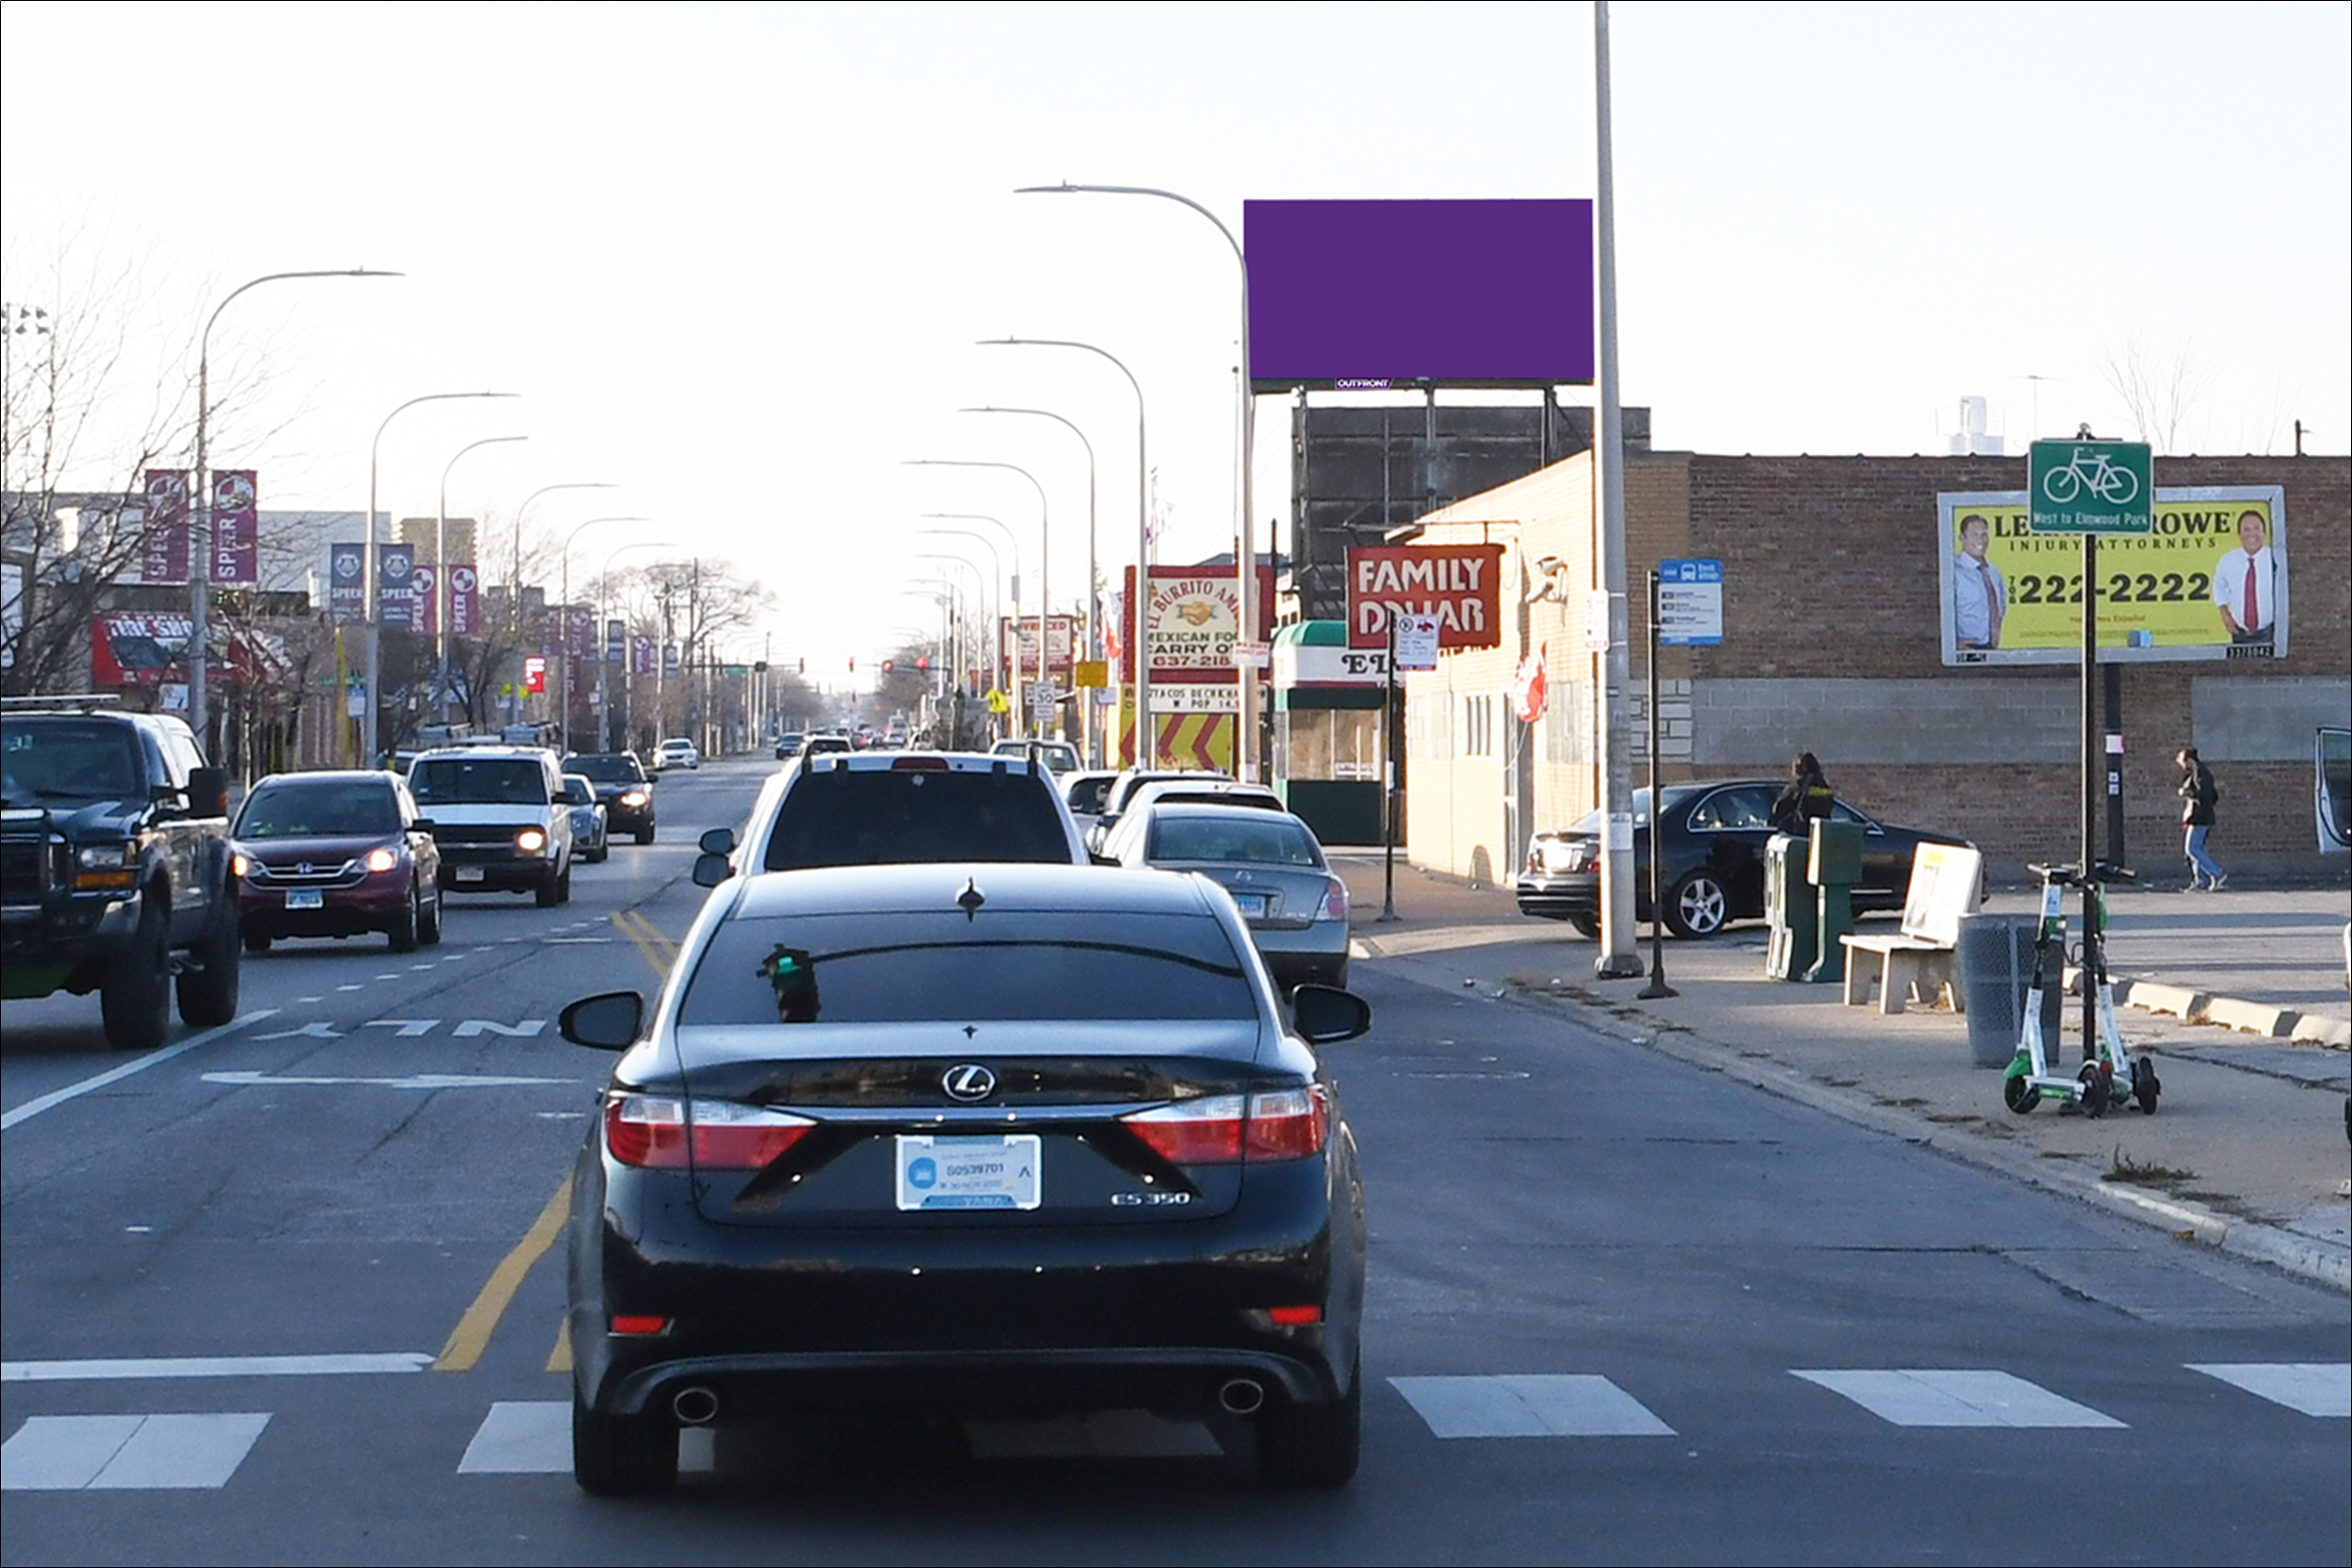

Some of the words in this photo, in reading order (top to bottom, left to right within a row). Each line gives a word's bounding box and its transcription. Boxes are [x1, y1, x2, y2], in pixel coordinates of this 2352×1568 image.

[1337, 378, 1389, 387] OUTFRONT
[2033, 512, 2058, 525] West
[2061, 513, 2072, 524] to
[2076, 512, 2120, 525] Elmwood
[2124, 513, 2148, 525] Park
[2010, 540, 2082, 553] INJURY
[2095, 537, 2216, 551] ATTORNEYS
[1358, 558, 1485, 593] FAMILY
[1155, 580, 1213, 612] BURRITO
[1215, 632, 1238, 643] FO
[1152, 656, 1232, 665] 637-218
[1111, 1194, 1143, 1205] ES
[1147, 1192, 1190, 1205] 350
